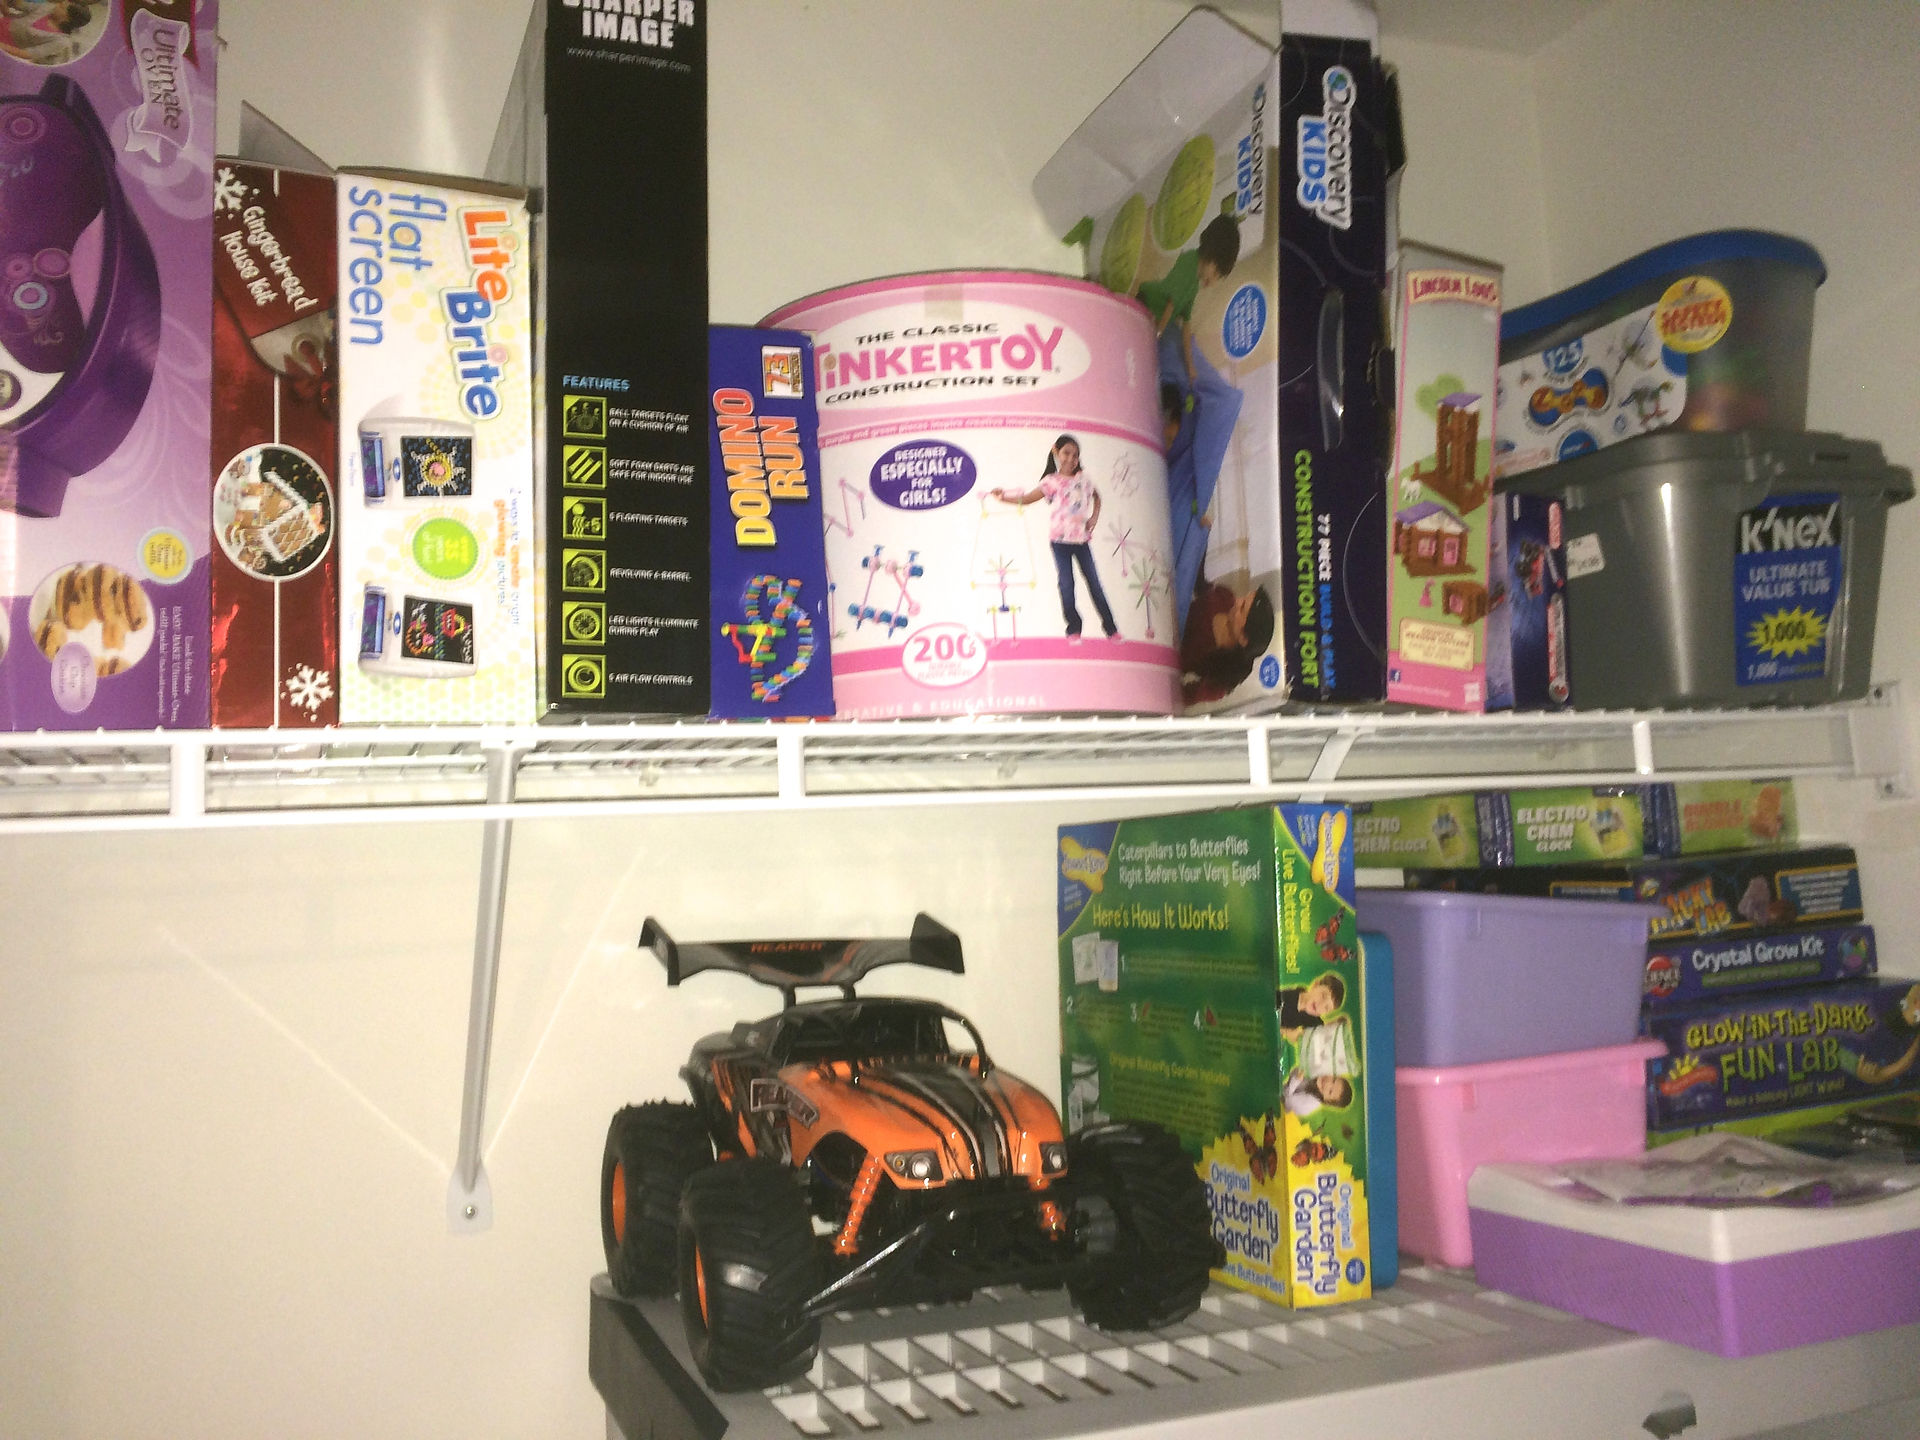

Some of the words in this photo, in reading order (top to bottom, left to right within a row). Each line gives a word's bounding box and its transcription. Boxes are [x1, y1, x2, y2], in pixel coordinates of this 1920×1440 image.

[582, 10, 674, 48] IMAGE
[566, 48, 691, 73] www.sharperimage.com
[140, 48, 164, 106] OVEN
[152, 28, 183, 130] Ultimate
[1236, 135, 1253, 211] KIDS
[1302, 120, 1327, 203] KIDS
[389, 192, 448, 271] flat
[219, 230, 260, 281] House
[243, 205, 319, 312] Gingerbread
[349, 186, 384, 345] screen
[463, 210, 519, 301] Lite
[246, 276, 279, 307] Kit
[856, 331, 895, 345] THE
[902, 323, 999, 338] CLASSIC
[446, 291, 508, 416] Brite
[563, 375, 631, 391] FEATURES
[765, 354, 791, 391] 73
[825, 376, 994, 404] CONSTRUCTION
[1003, 376, 1041, 387] SET
[609, 407, 630, 418] BALL
[631, 409, 666, 421] TARGETS
[666, 412, 690, 424] FLOAT
[629, 420, 664, 432] CUSHION
[609, 459, 630, 469] SOFT
[630, 460, 653, 471] FOAM
[653, 462, 679, 473] DARTS
[713, 387, 778, 546] DOMINO
[758, 416, 810, 500] RUN
[880, 456, 964, 482] ESPECIALLY
[894, 446, 948, 462] DESIGNED
[609, 469, 630, 480] SAFE
[630, 470, 648, 481] FOR
[648, 471, 677, 483] INDOOR
[911, 476, 933, 490] FOR
[899, 487, 947, 508] GIRLS!
[615, 512, 654, 525] FLOATING
[654, 514, 689, 527] TARGETS
[1317, 513, 1332, 537] 77
[1294, 449, 1316, 625] CONSTRUCTION
[610, 567, 653, 580] REVOLVING
[1317, 537, 1332, 582] PIECE
[1749, 560, 1829, 583] ULTIMATE
[1741, 581, 1796, 602] VALUE
[1800, 577, 1832, 596] TUB
[608, 614, 626, 626] LED
[625, 615, 654, 627] LIGHTS
[654, 617, 700, 630] ILLUMINATE
[608, 625, 640, 637] DURING
[639, 626, 660, 638] PLAY
[1762, 619, 1807, 645] 1,000
[1299, 630, 1320, 689] FORT
[629, 673, 652, 684] FLOW
[652, 674, 694, 686] CONTROLS
[1517, 805, 1590, 824] ELECTRO
[1393, 838, 1429, 852] CLOCK
[1527, 822, 1574, 841] CHEM
[1536, 840, 1573, 852] CLOCK
[1118, 842, 1173, 863] Caterpillars
[1176, 841, 1187, 859] to
[1190, 836, 1249, 858] Butterflies
[1282, 849, 1297, 879] Live
[1119, 866, 1143, 890] Right
[1145, 865, 1177, 884] Before
[1178, 864, 1202, 882] Your
[1203, 863, 1229, 888] Very
[1232, 859, 1262, 888] Eyes!
[1093, 903, 1129, 929] Here's
[1131, 903, 1161, 929] How
[1164, 903, 1176, 929] It
[1178, 903, 1230, 931] Works!
[1299, 888, 1314, 934] Grow
[1283, 882, 1300, 975] Butterflies!
[751, 942, 823, 953] REAPER
[1691, 943, 1751, 973] Crystal
[1755, 941, 1799, 963] Grow
[1800, 935, 1825, 956] Kit
[1066, 995, 1074, 1014] 2
[1720, 1041, 1775, 1092] FUN
[1211, 1162, 1250, 1194] Original
[1205, 1185, 1279, 1244] Butterfly
[1338, 1183, 1354, 1249] Original
[1212, 1215, 1272, 1265] Garden
[1294, 1188, 1317, 1286] Garden
[1315, 1174, 1341, 1296] Butterfly
